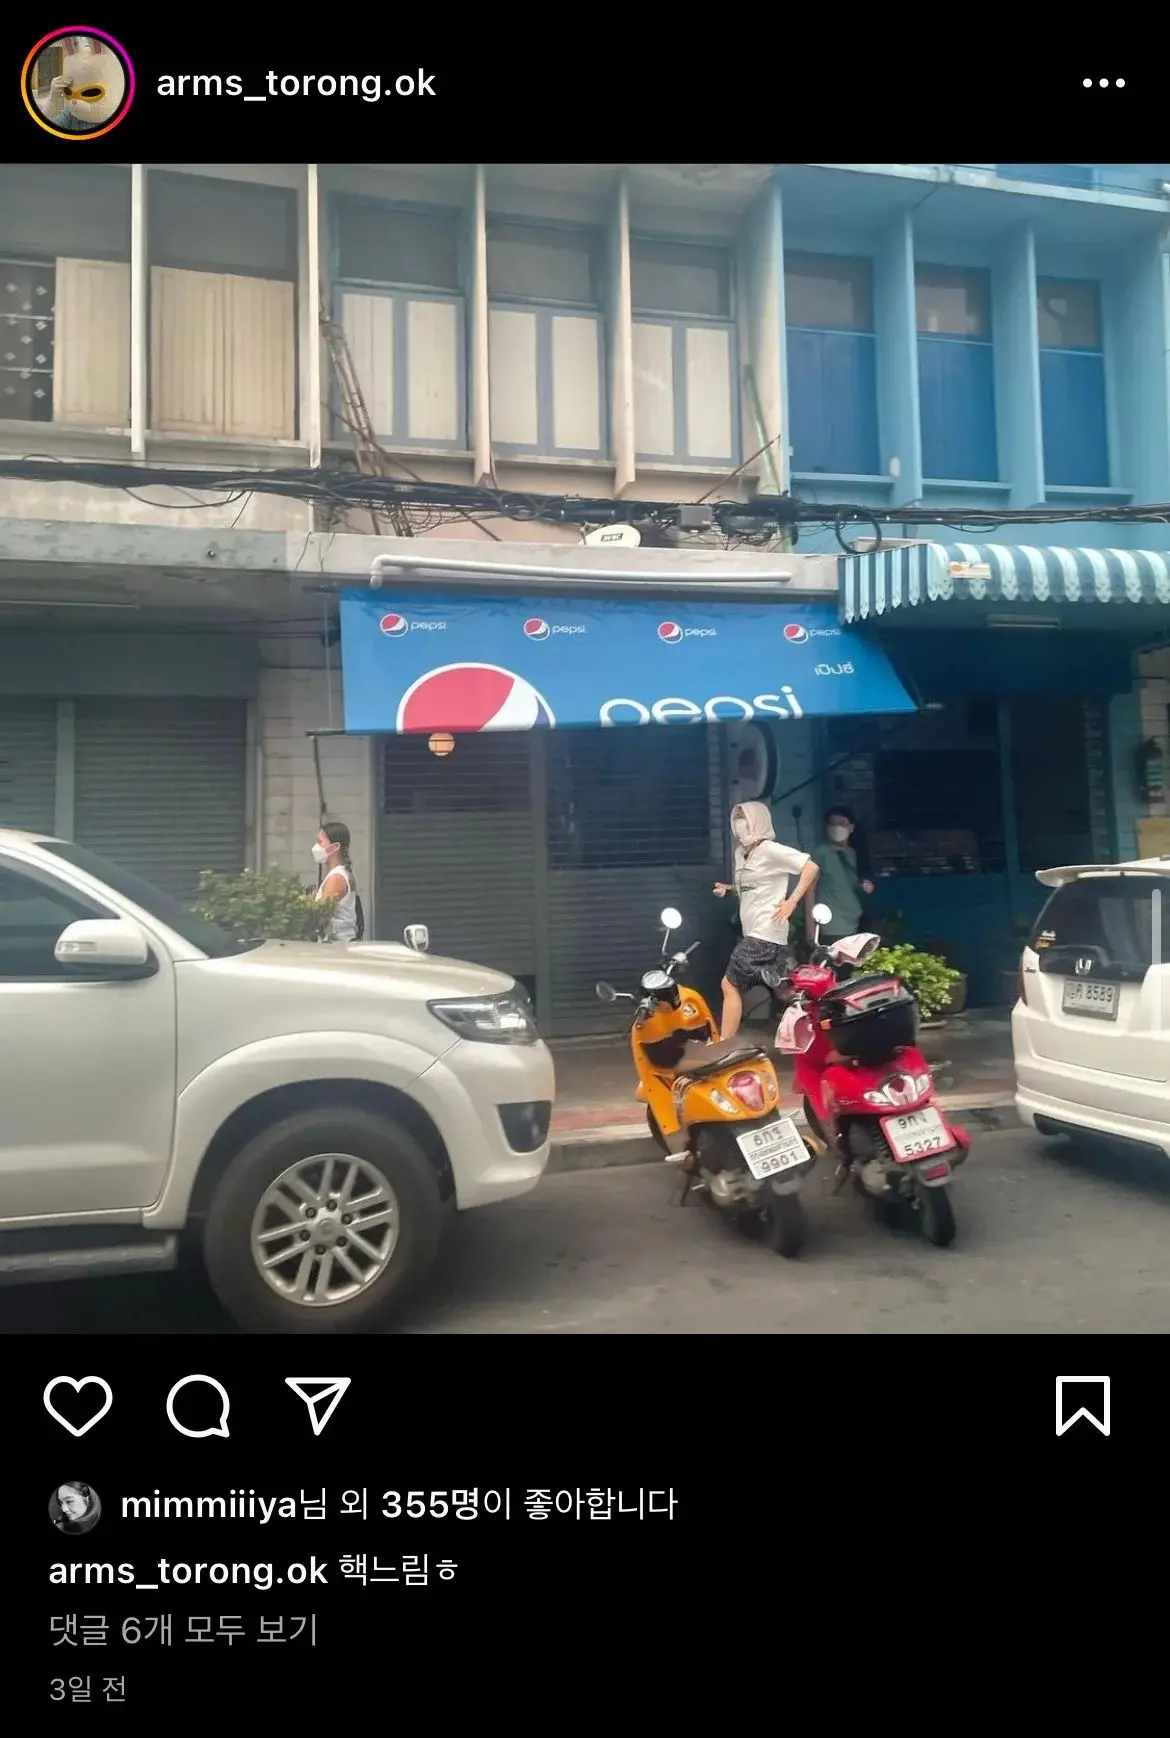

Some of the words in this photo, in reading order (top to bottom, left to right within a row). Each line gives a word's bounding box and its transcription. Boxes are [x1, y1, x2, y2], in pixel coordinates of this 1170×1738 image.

[410, 619, 447, 634] pepsi
[551, 623, 587, 636] pepsi
[684, 626, 718, 639] pepsi
[903, 1135, 942, 1156] 5327
[761, 1150, 799, 1173] 9901
